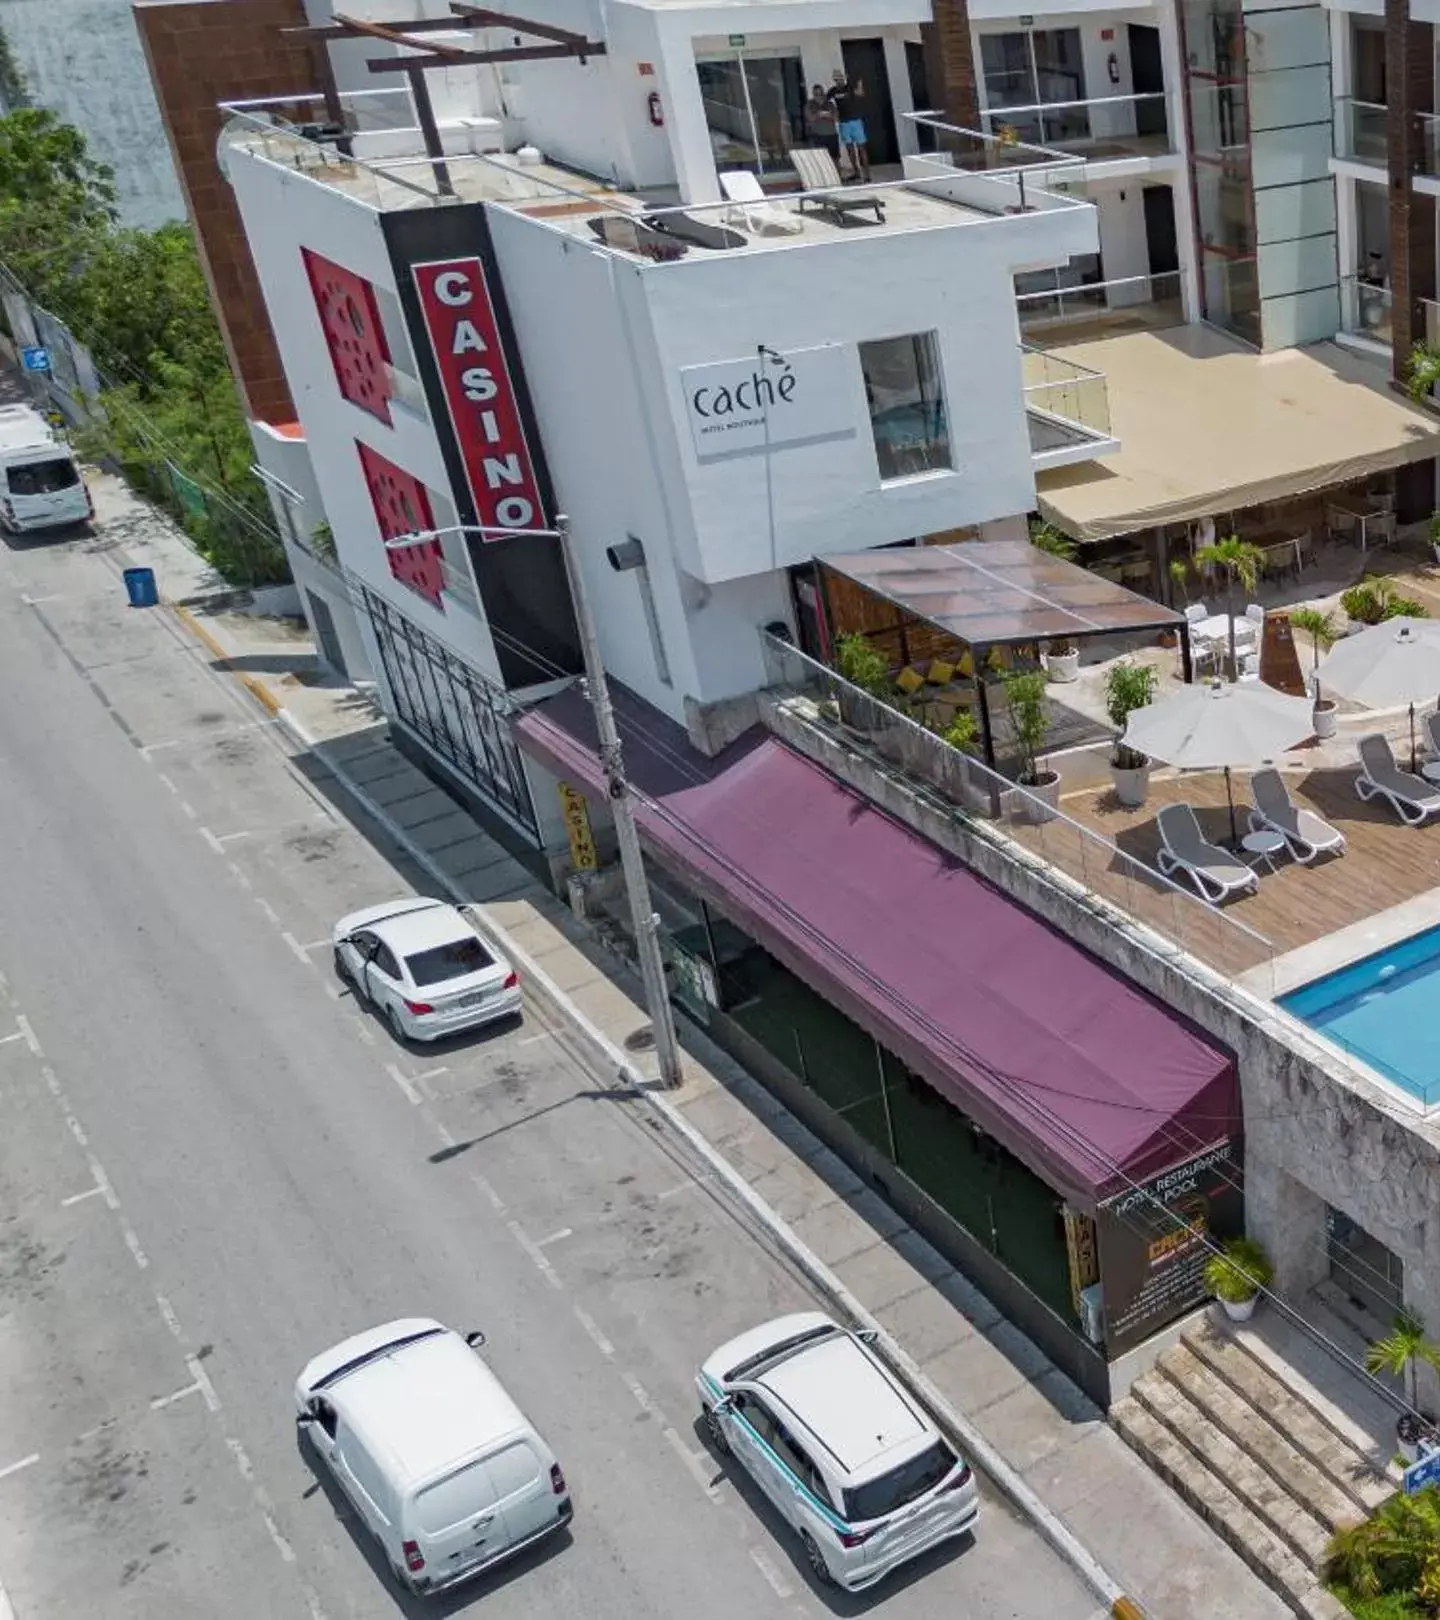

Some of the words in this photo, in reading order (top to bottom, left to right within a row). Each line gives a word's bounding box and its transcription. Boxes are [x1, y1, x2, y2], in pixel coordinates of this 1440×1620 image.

[433, 271, 533, 527] CASINO
[693, 365, 796, 417] caché
[1164, 1179, 1198, 1201] POOL
